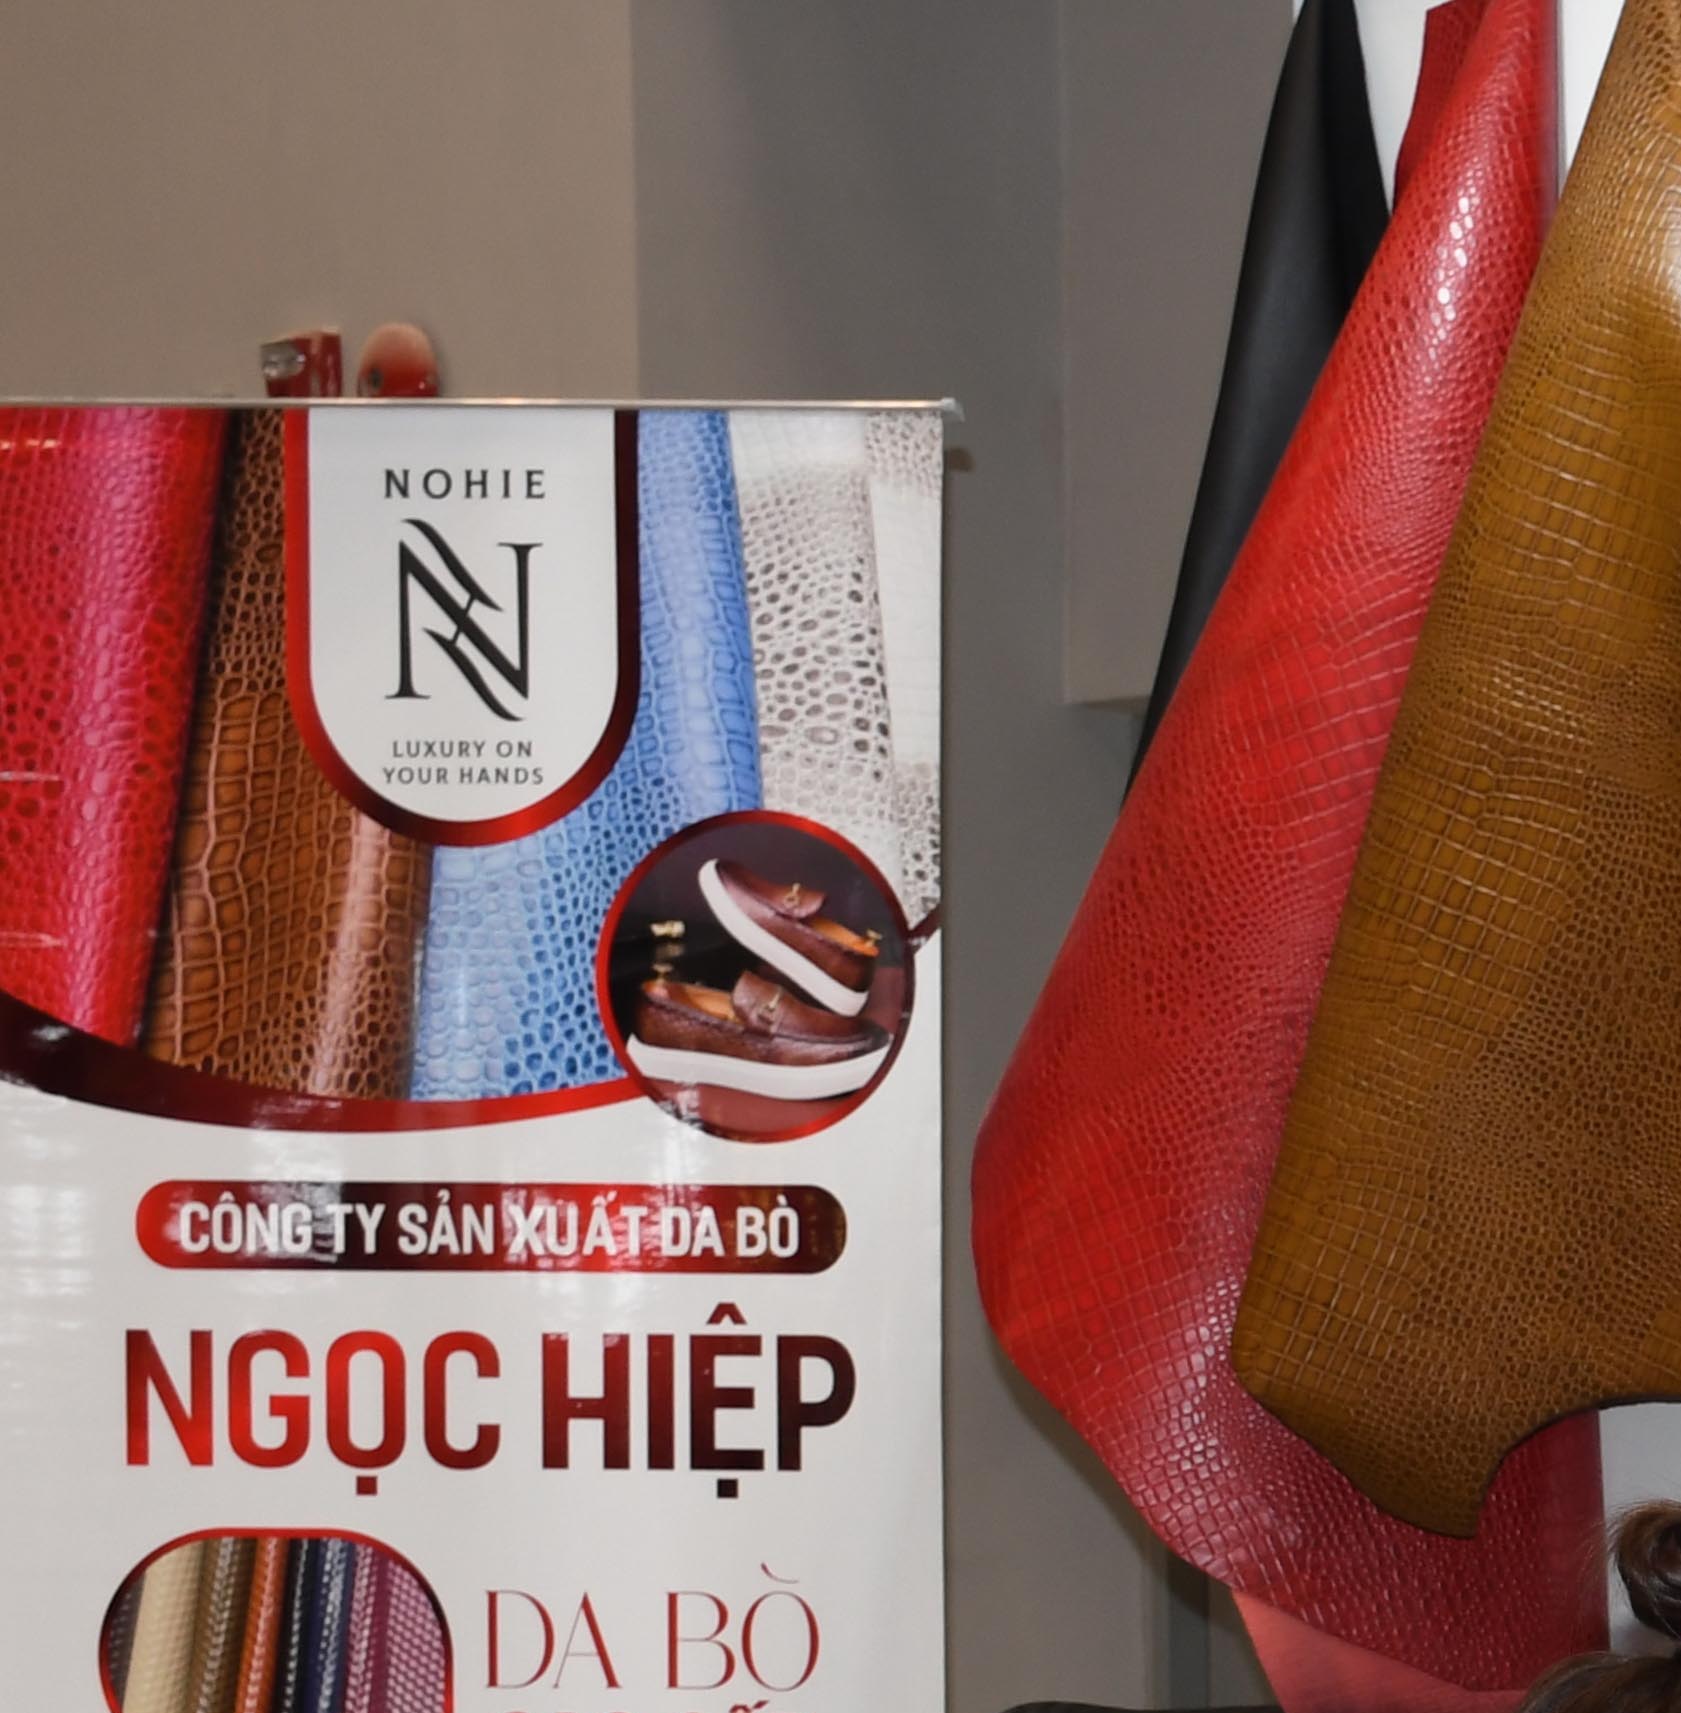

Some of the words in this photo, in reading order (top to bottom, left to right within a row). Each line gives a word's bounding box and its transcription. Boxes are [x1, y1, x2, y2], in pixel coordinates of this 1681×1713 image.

[384, 468, 545, 500] NOHIE
[392, 739, 486, 759] LUXURY
[495, 739, 533, 759] ON
[382, 766, 449, 786] YOUR
[458, 766, 544, 786] HANDS
[180, 1191, 312, 1254] CÔNG
[325, 1205, 384, 1255] TY
[399, 1190, 494, 1256] SẢN
[509, 1191, 648, 1257] XUẤT
[661, 1206, 724, 1258] DA
[738, 1197, 799, 1259] BÒ
[124, 1327, 501, 1498] NGỌC
[541, 1301, 857, 1500] HIỆP
[486, 1589, 620, 1690] DA
[667, 1562, 820, 1692] BÒ
